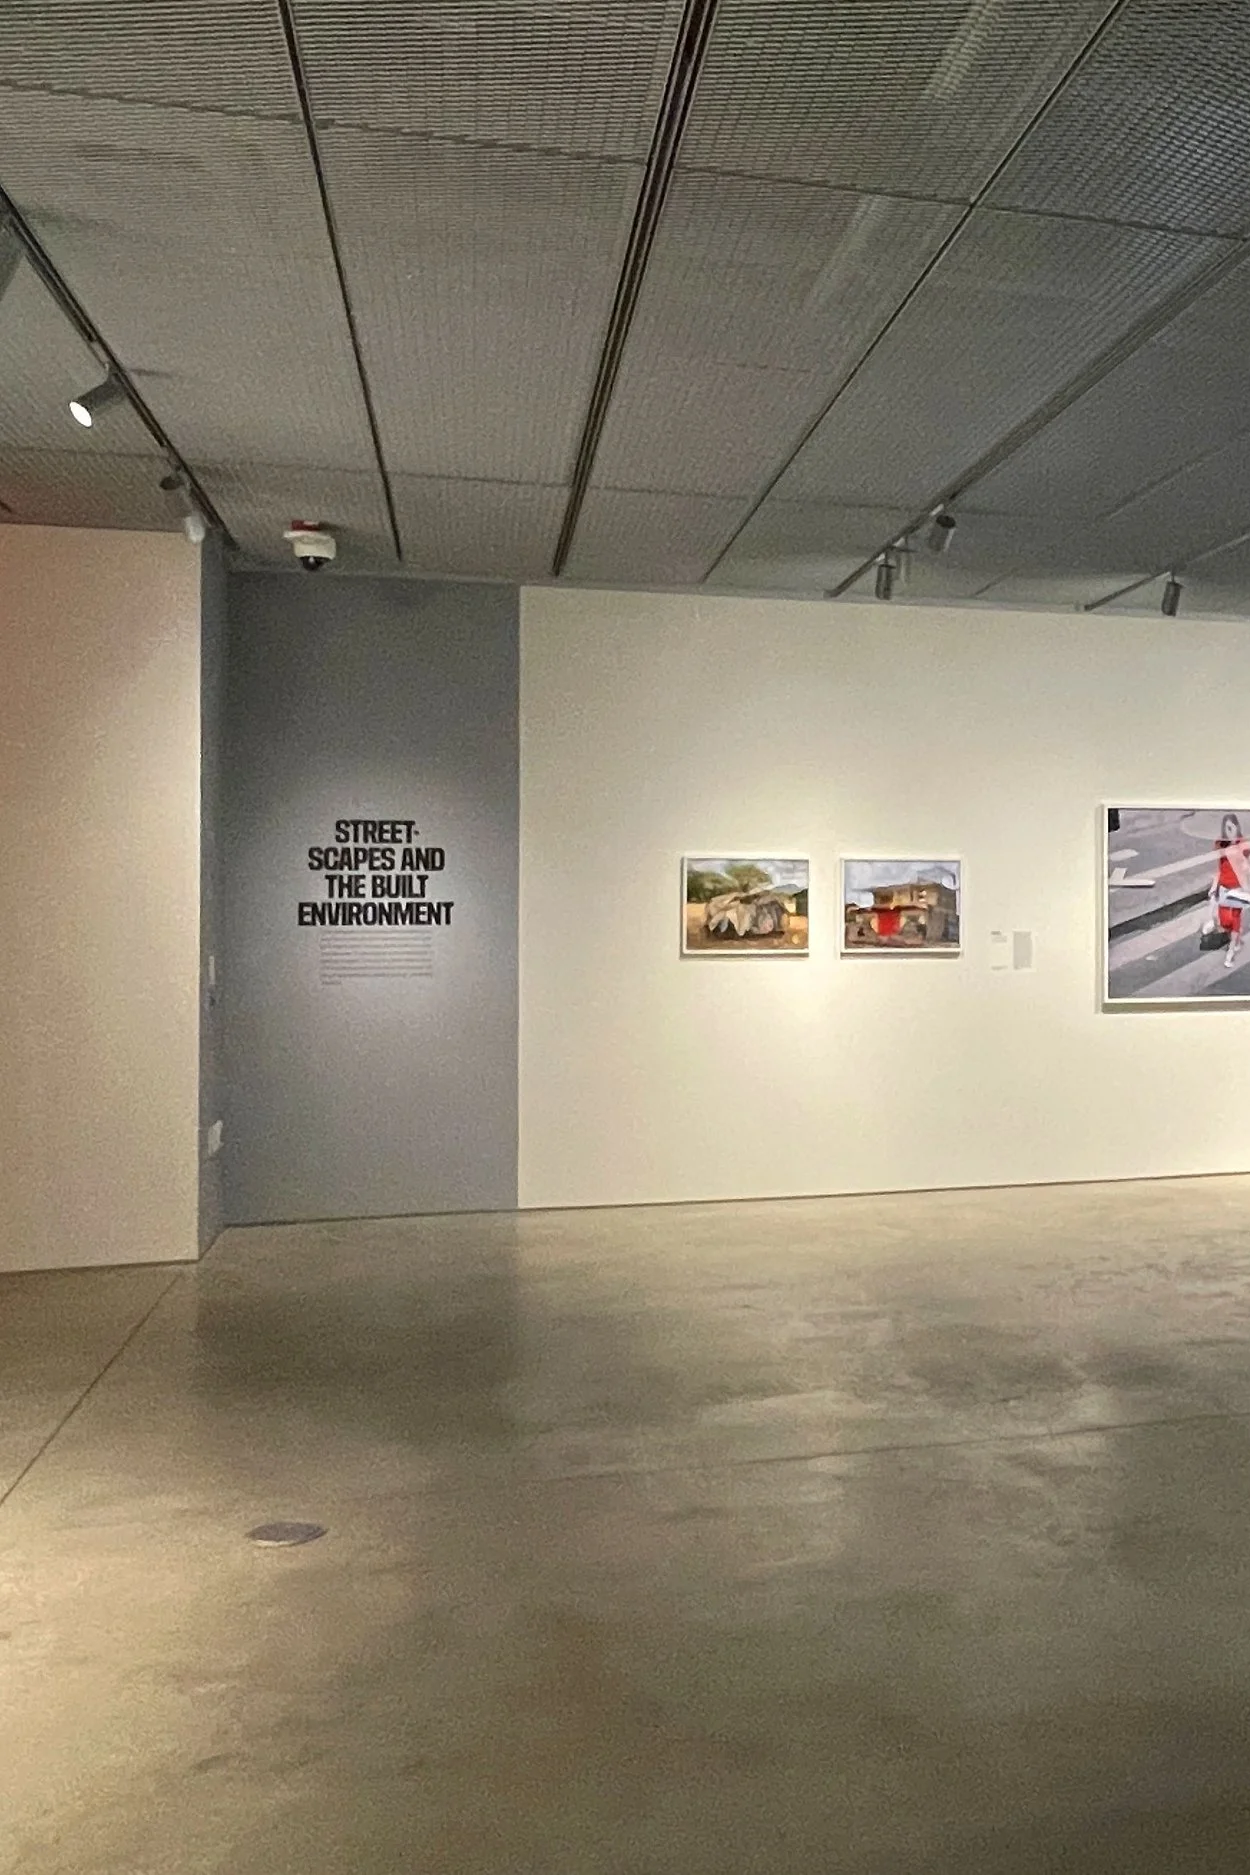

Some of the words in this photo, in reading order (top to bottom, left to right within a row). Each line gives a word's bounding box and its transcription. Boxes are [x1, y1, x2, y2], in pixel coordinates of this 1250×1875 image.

[308, 847, 396, 871] SCAPES
[401, 847, 445, 871] AND
[324, 875, 366, 898] THE
[371, 875, 429, 898] BUILT
[297, 902, 454, 925] ENVIRONMENT
